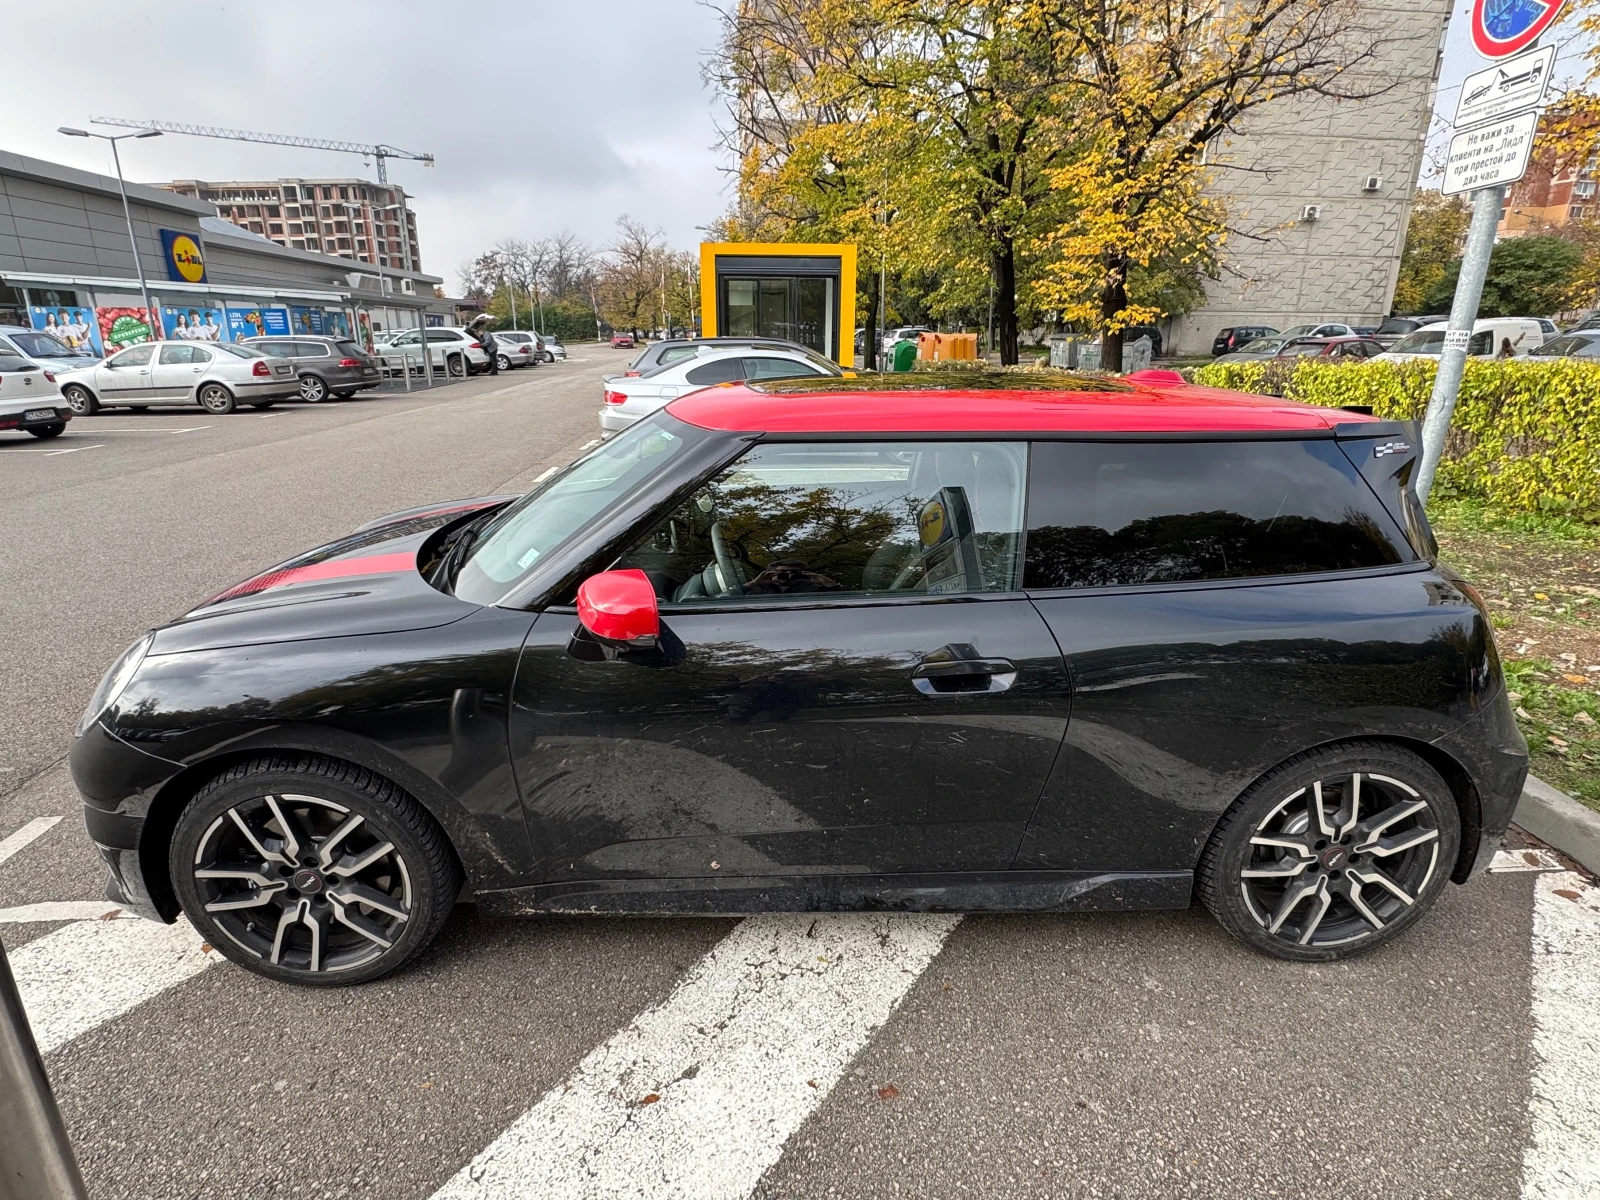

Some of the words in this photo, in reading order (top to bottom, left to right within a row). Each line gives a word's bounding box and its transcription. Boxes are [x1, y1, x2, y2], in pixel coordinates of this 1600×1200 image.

[1467, 134, 1479, 146] Не
[1480, 128, 1502, 142] важи
[1504, 124, 1515, 135] за
[1449, 147, 1482, 163] клиенти
[1483, 144, 1494, 154] на
[1454, 163, 1469, 176] при
[1470, 152, 1504, 172] престой
[1504, 151, 1517, 164] до
[1462, 174, 1478, 187] два
[1480, 169, 1500, 182] часа
